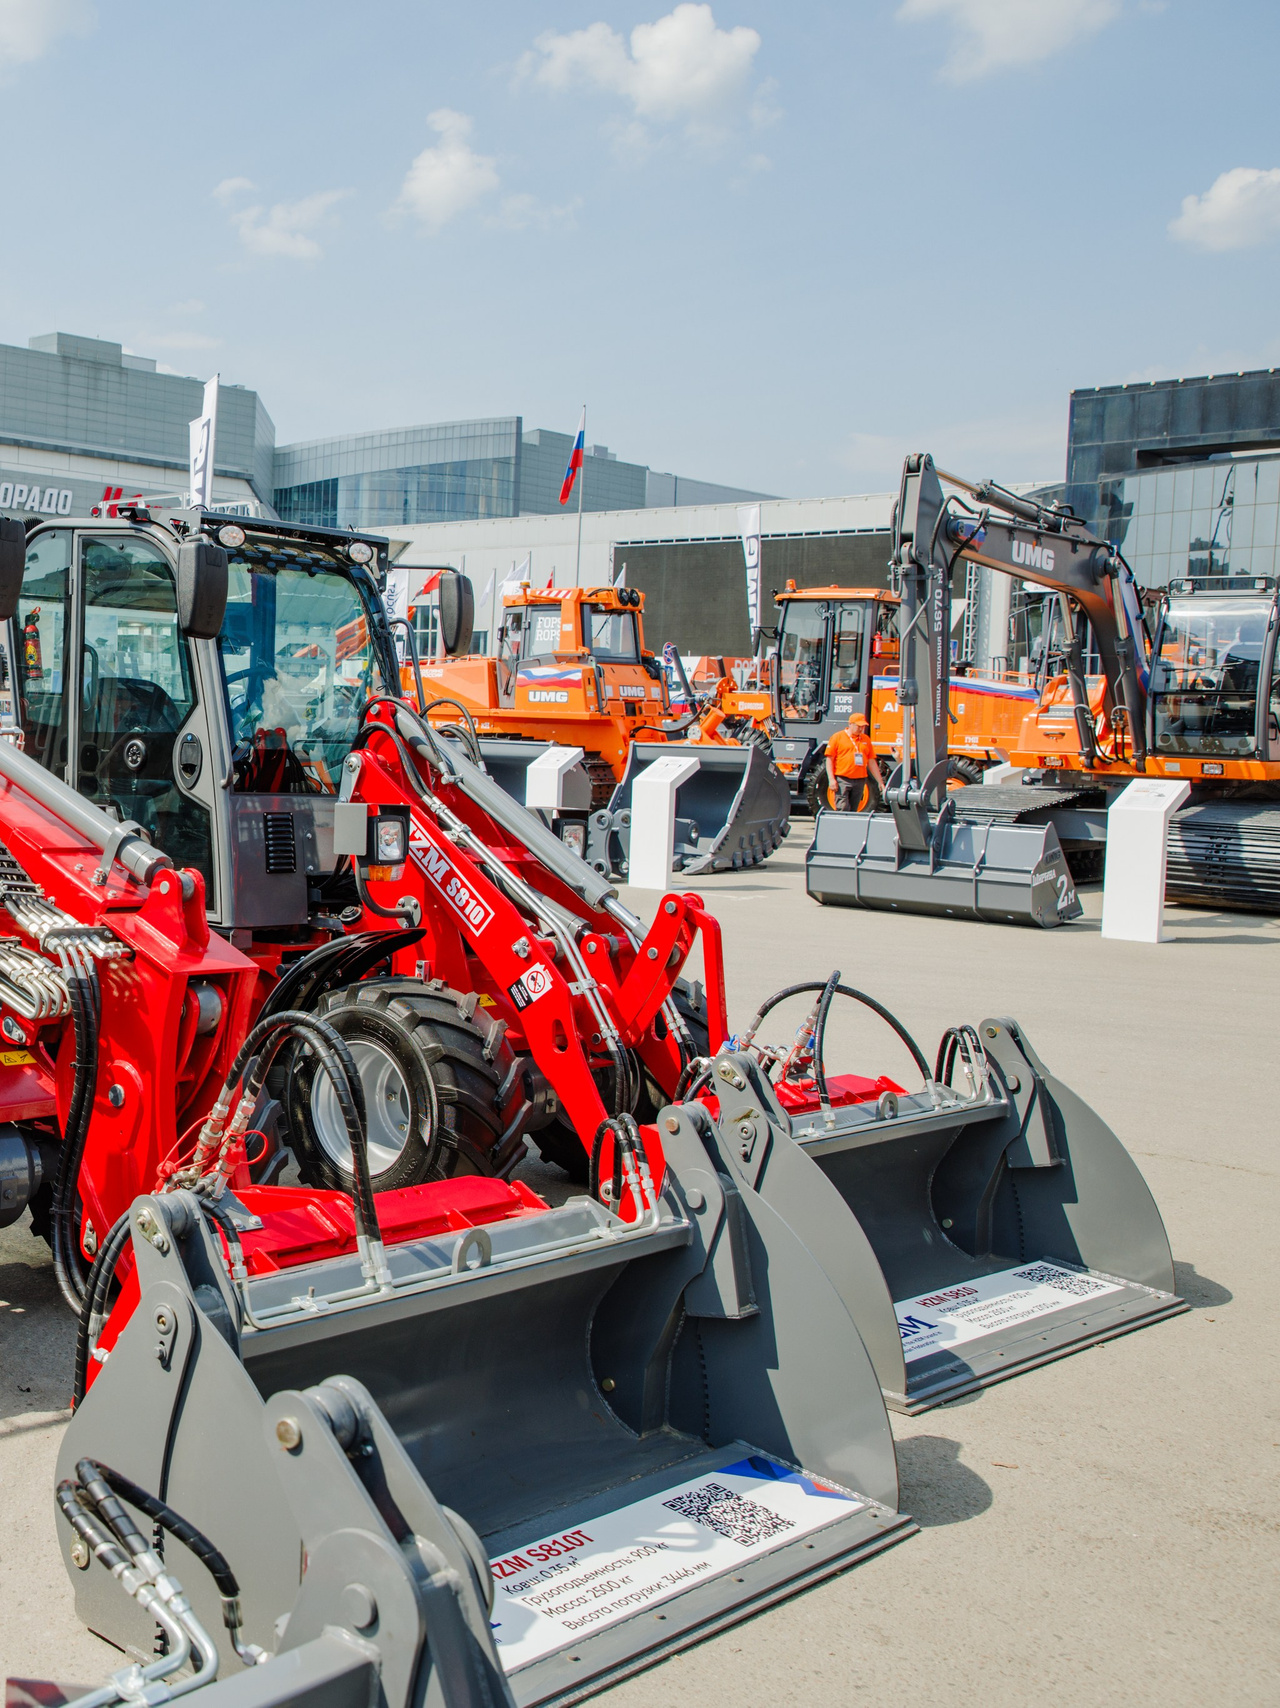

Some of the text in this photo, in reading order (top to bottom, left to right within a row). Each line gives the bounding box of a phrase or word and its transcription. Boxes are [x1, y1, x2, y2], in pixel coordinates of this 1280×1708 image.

[1011, 540, 1055, 571] UMG
[934, 589, 943, 632] 5670
[528, 690, 569, 703] UMG
[619, 685, 645, 697] UMG
[834, 695, 853, 704] FOPS
[833, 704, 853, 713] ROPS
[446, 876, 486, 926] S810
[915, 1286, 979, 1308] HZM S810
[490, 1529, 595, 1580] ZM S810T
[502, 1575, 545, 1595] Ковш:
[539, 1563, 570, 1580] 0.35
[521, 1541, 670, 1608] Грузоподъемность: 900 кг
[541, 1574, 634, 1619] Масса: 2500 кг
[561, 1561, 712, 1631] Высота погрузки: 3446 мм
